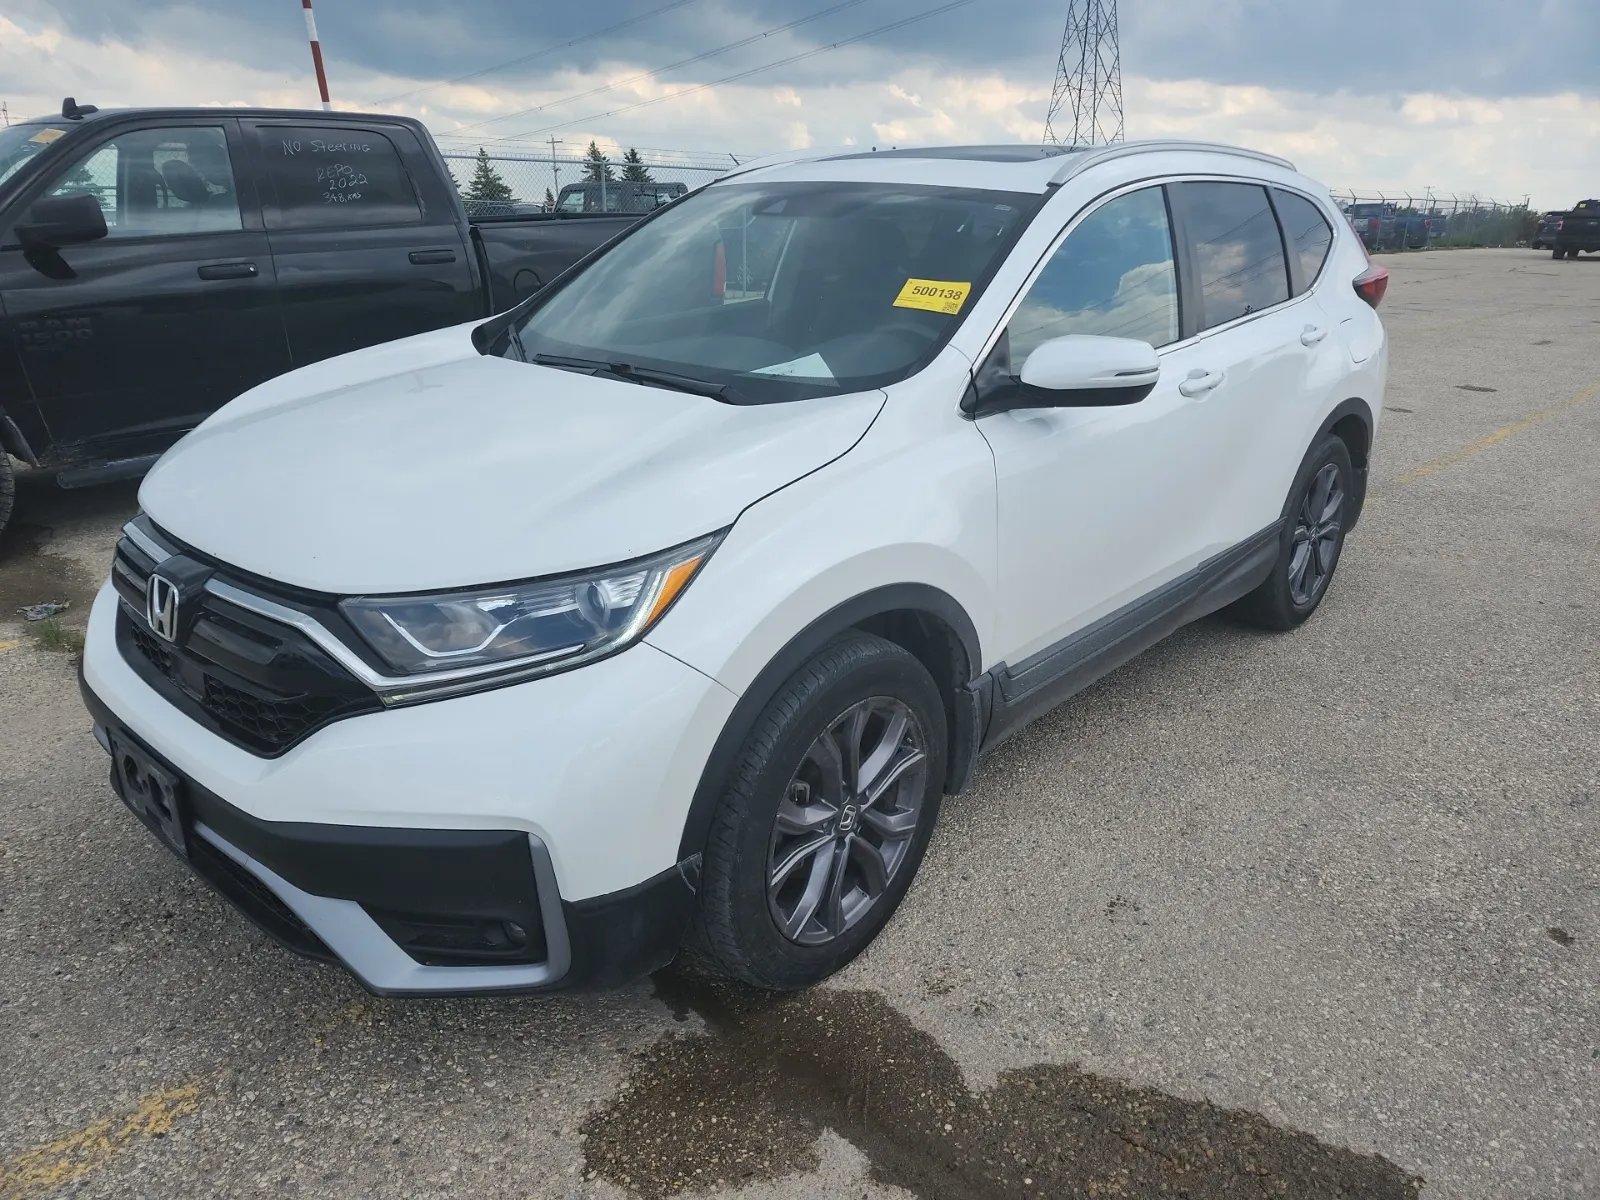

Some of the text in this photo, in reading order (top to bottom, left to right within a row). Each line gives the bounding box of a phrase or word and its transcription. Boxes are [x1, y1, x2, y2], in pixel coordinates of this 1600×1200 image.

[282, 139, 301, 155] NO
[329, 174, 368, 190] 2022
[911, 285, 963, 300] 500138
